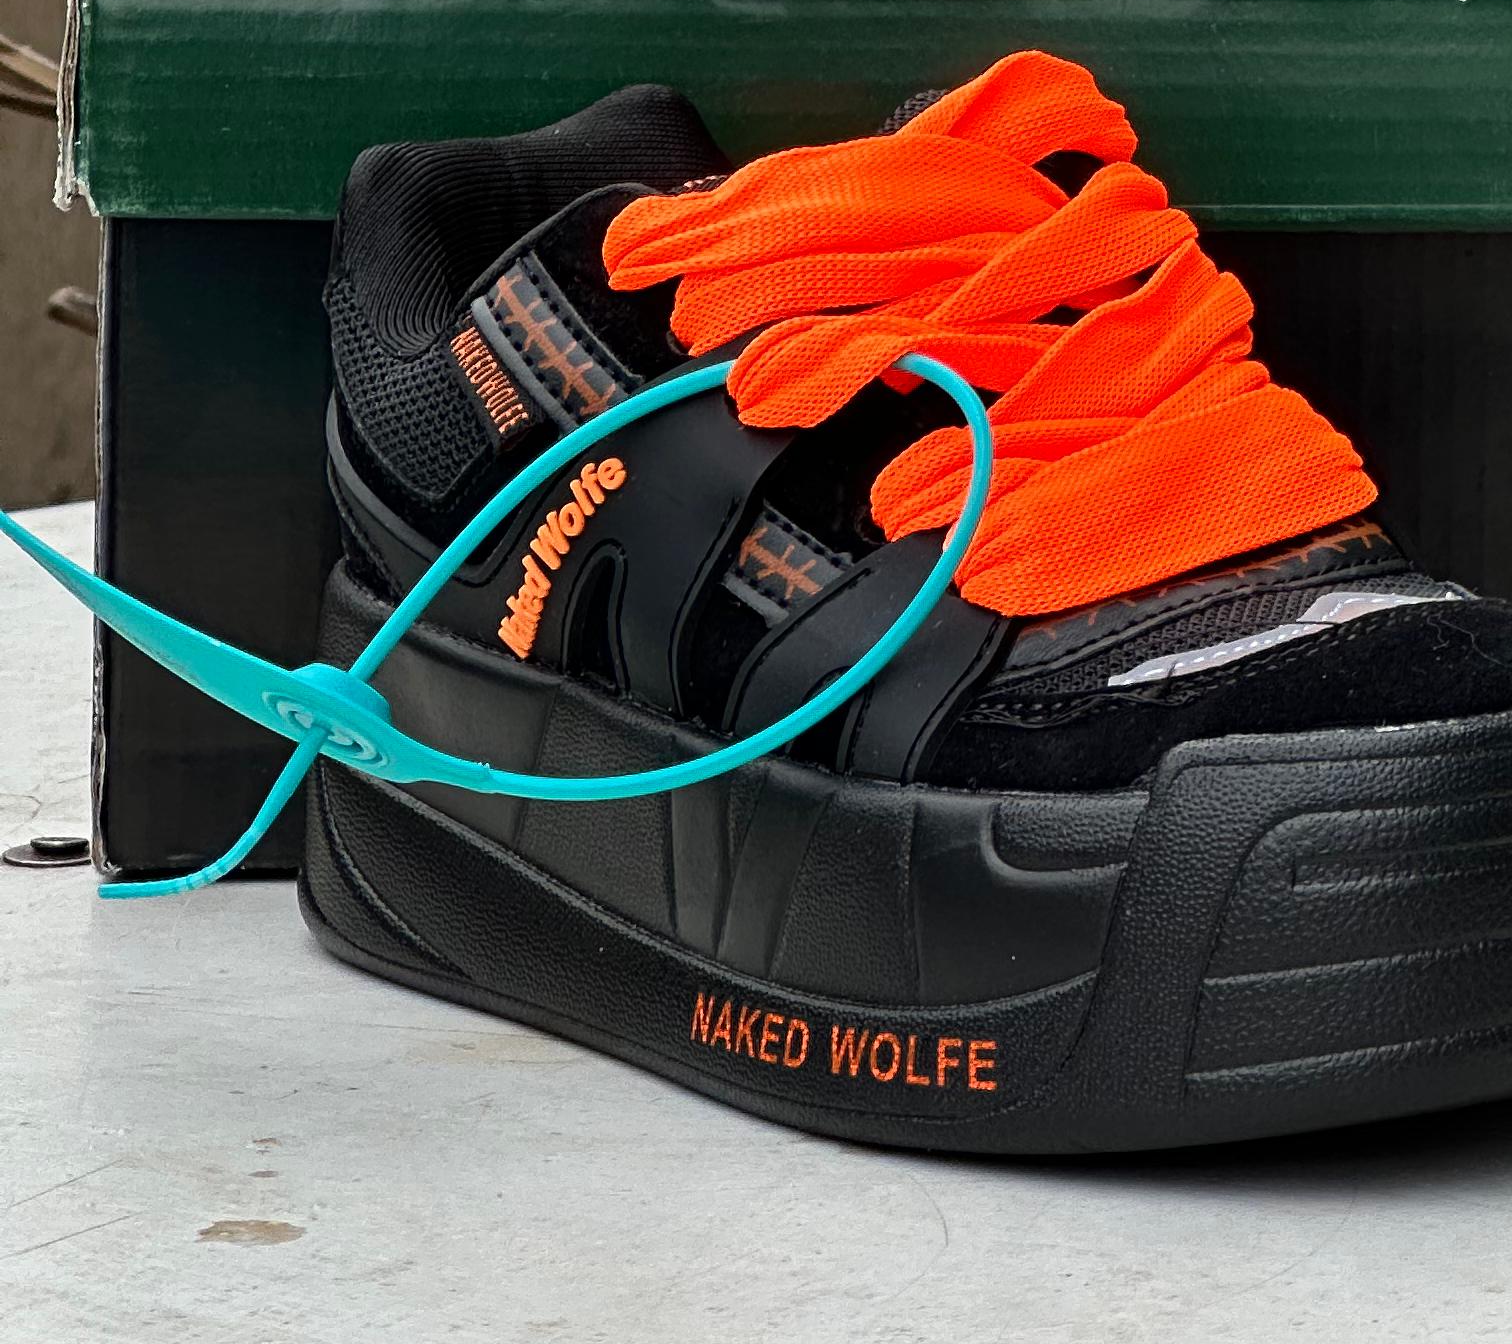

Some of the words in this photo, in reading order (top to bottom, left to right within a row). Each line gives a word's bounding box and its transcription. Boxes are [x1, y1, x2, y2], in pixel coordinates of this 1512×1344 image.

[530, 457, 628, 571] Wolfe
[690, 992, 810, 1069] NAKED
[830, 1024, 998, 1092] WOLFE
